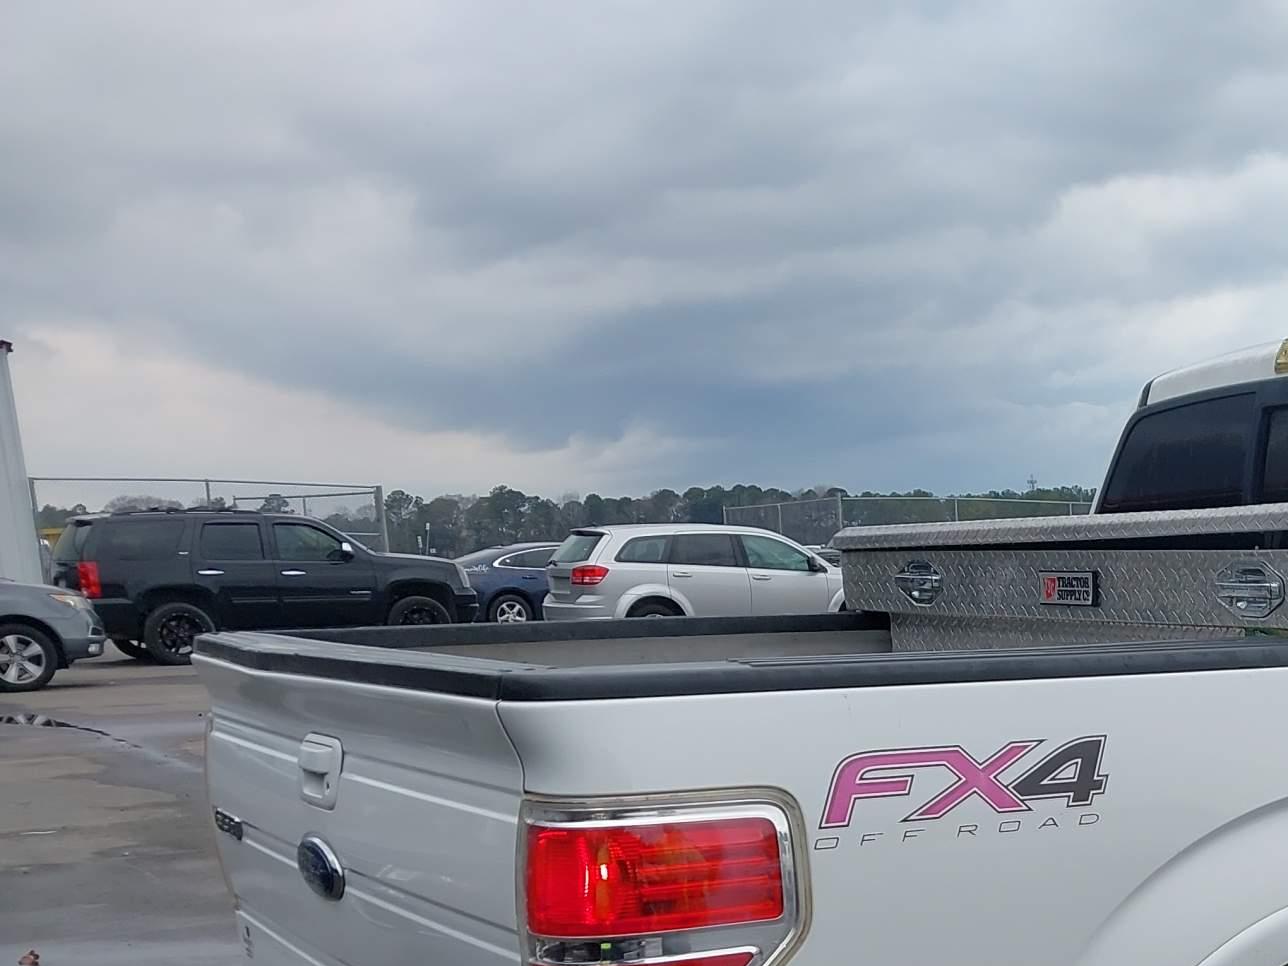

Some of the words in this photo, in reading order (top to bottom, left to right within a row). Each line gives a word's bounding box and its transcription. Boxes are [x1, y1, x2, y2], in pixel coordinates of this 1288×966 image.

[1057, 576, 1090, 588] TRACTOR
[1057, 590, 1082, 600] SUPPLY
[818, 734, 1109, 830] FX4
